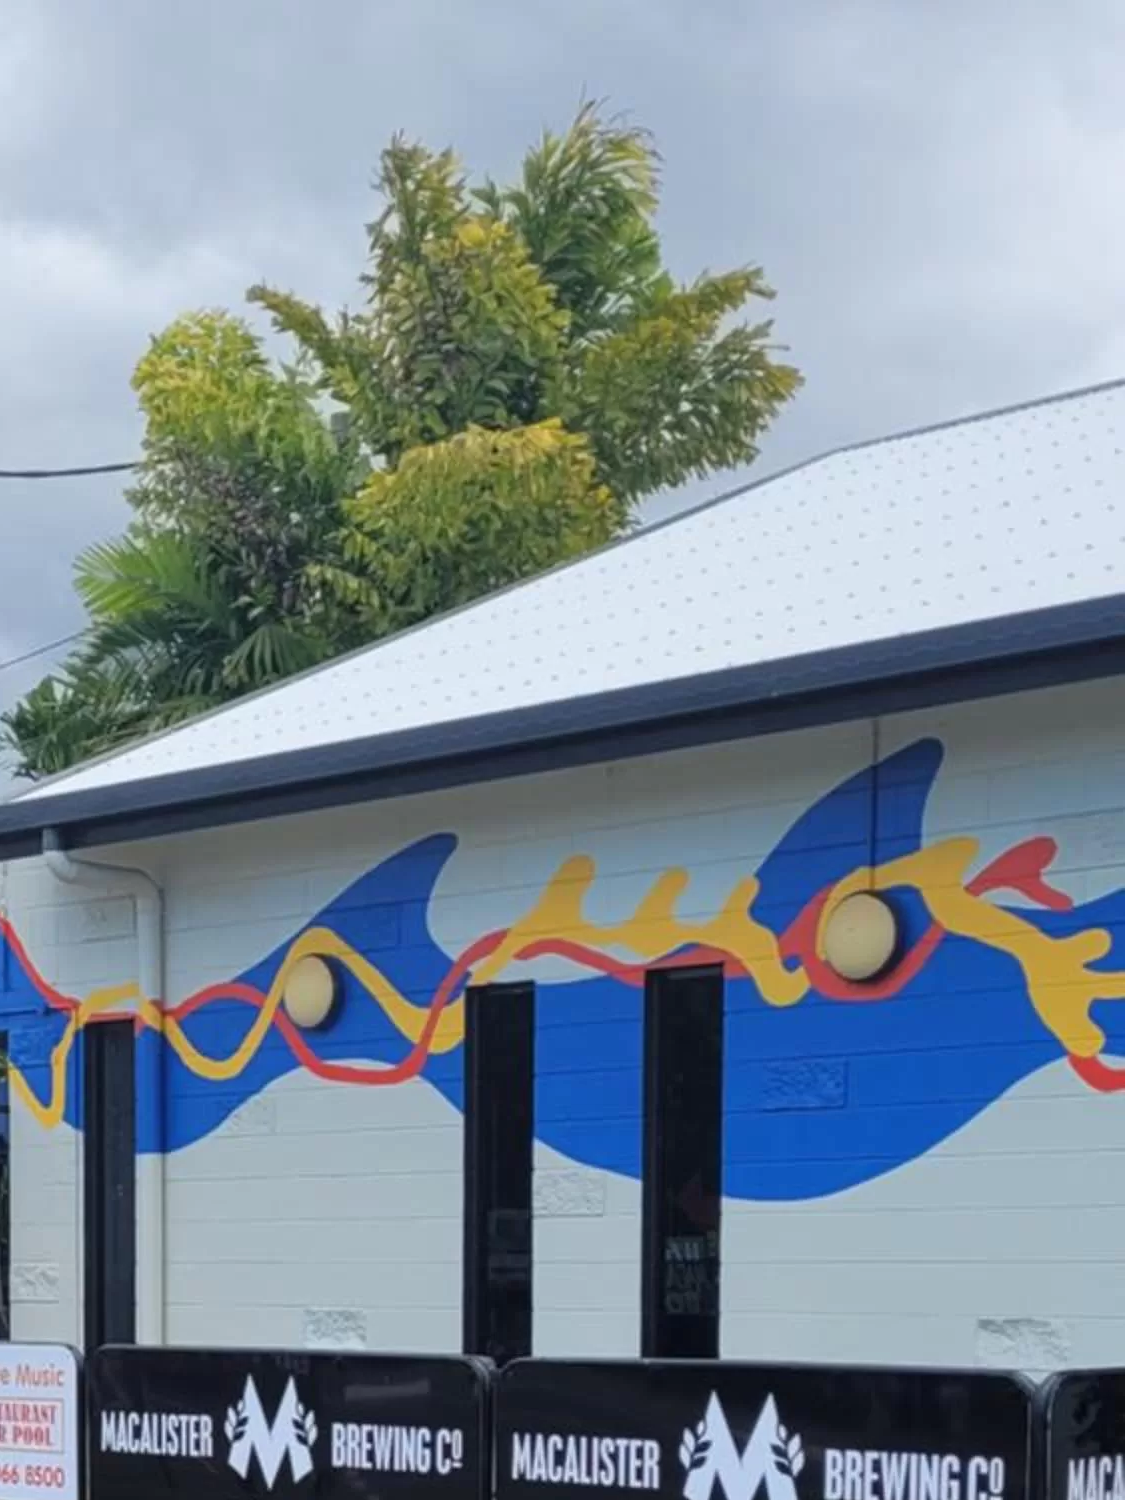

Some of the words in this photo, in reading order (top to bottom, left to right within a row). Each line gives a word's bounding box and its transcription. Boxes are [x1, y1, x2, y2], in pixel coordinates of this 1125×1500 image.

[16, 1363, 64, 1388] Music
[13, 1425, 52, 1446] POOL
[101, 1409, 213, 1458] MACALISTER
[332, 1421, 432, 1474] BREWING
[512, 1432, 660, 1490] MACALISTER
